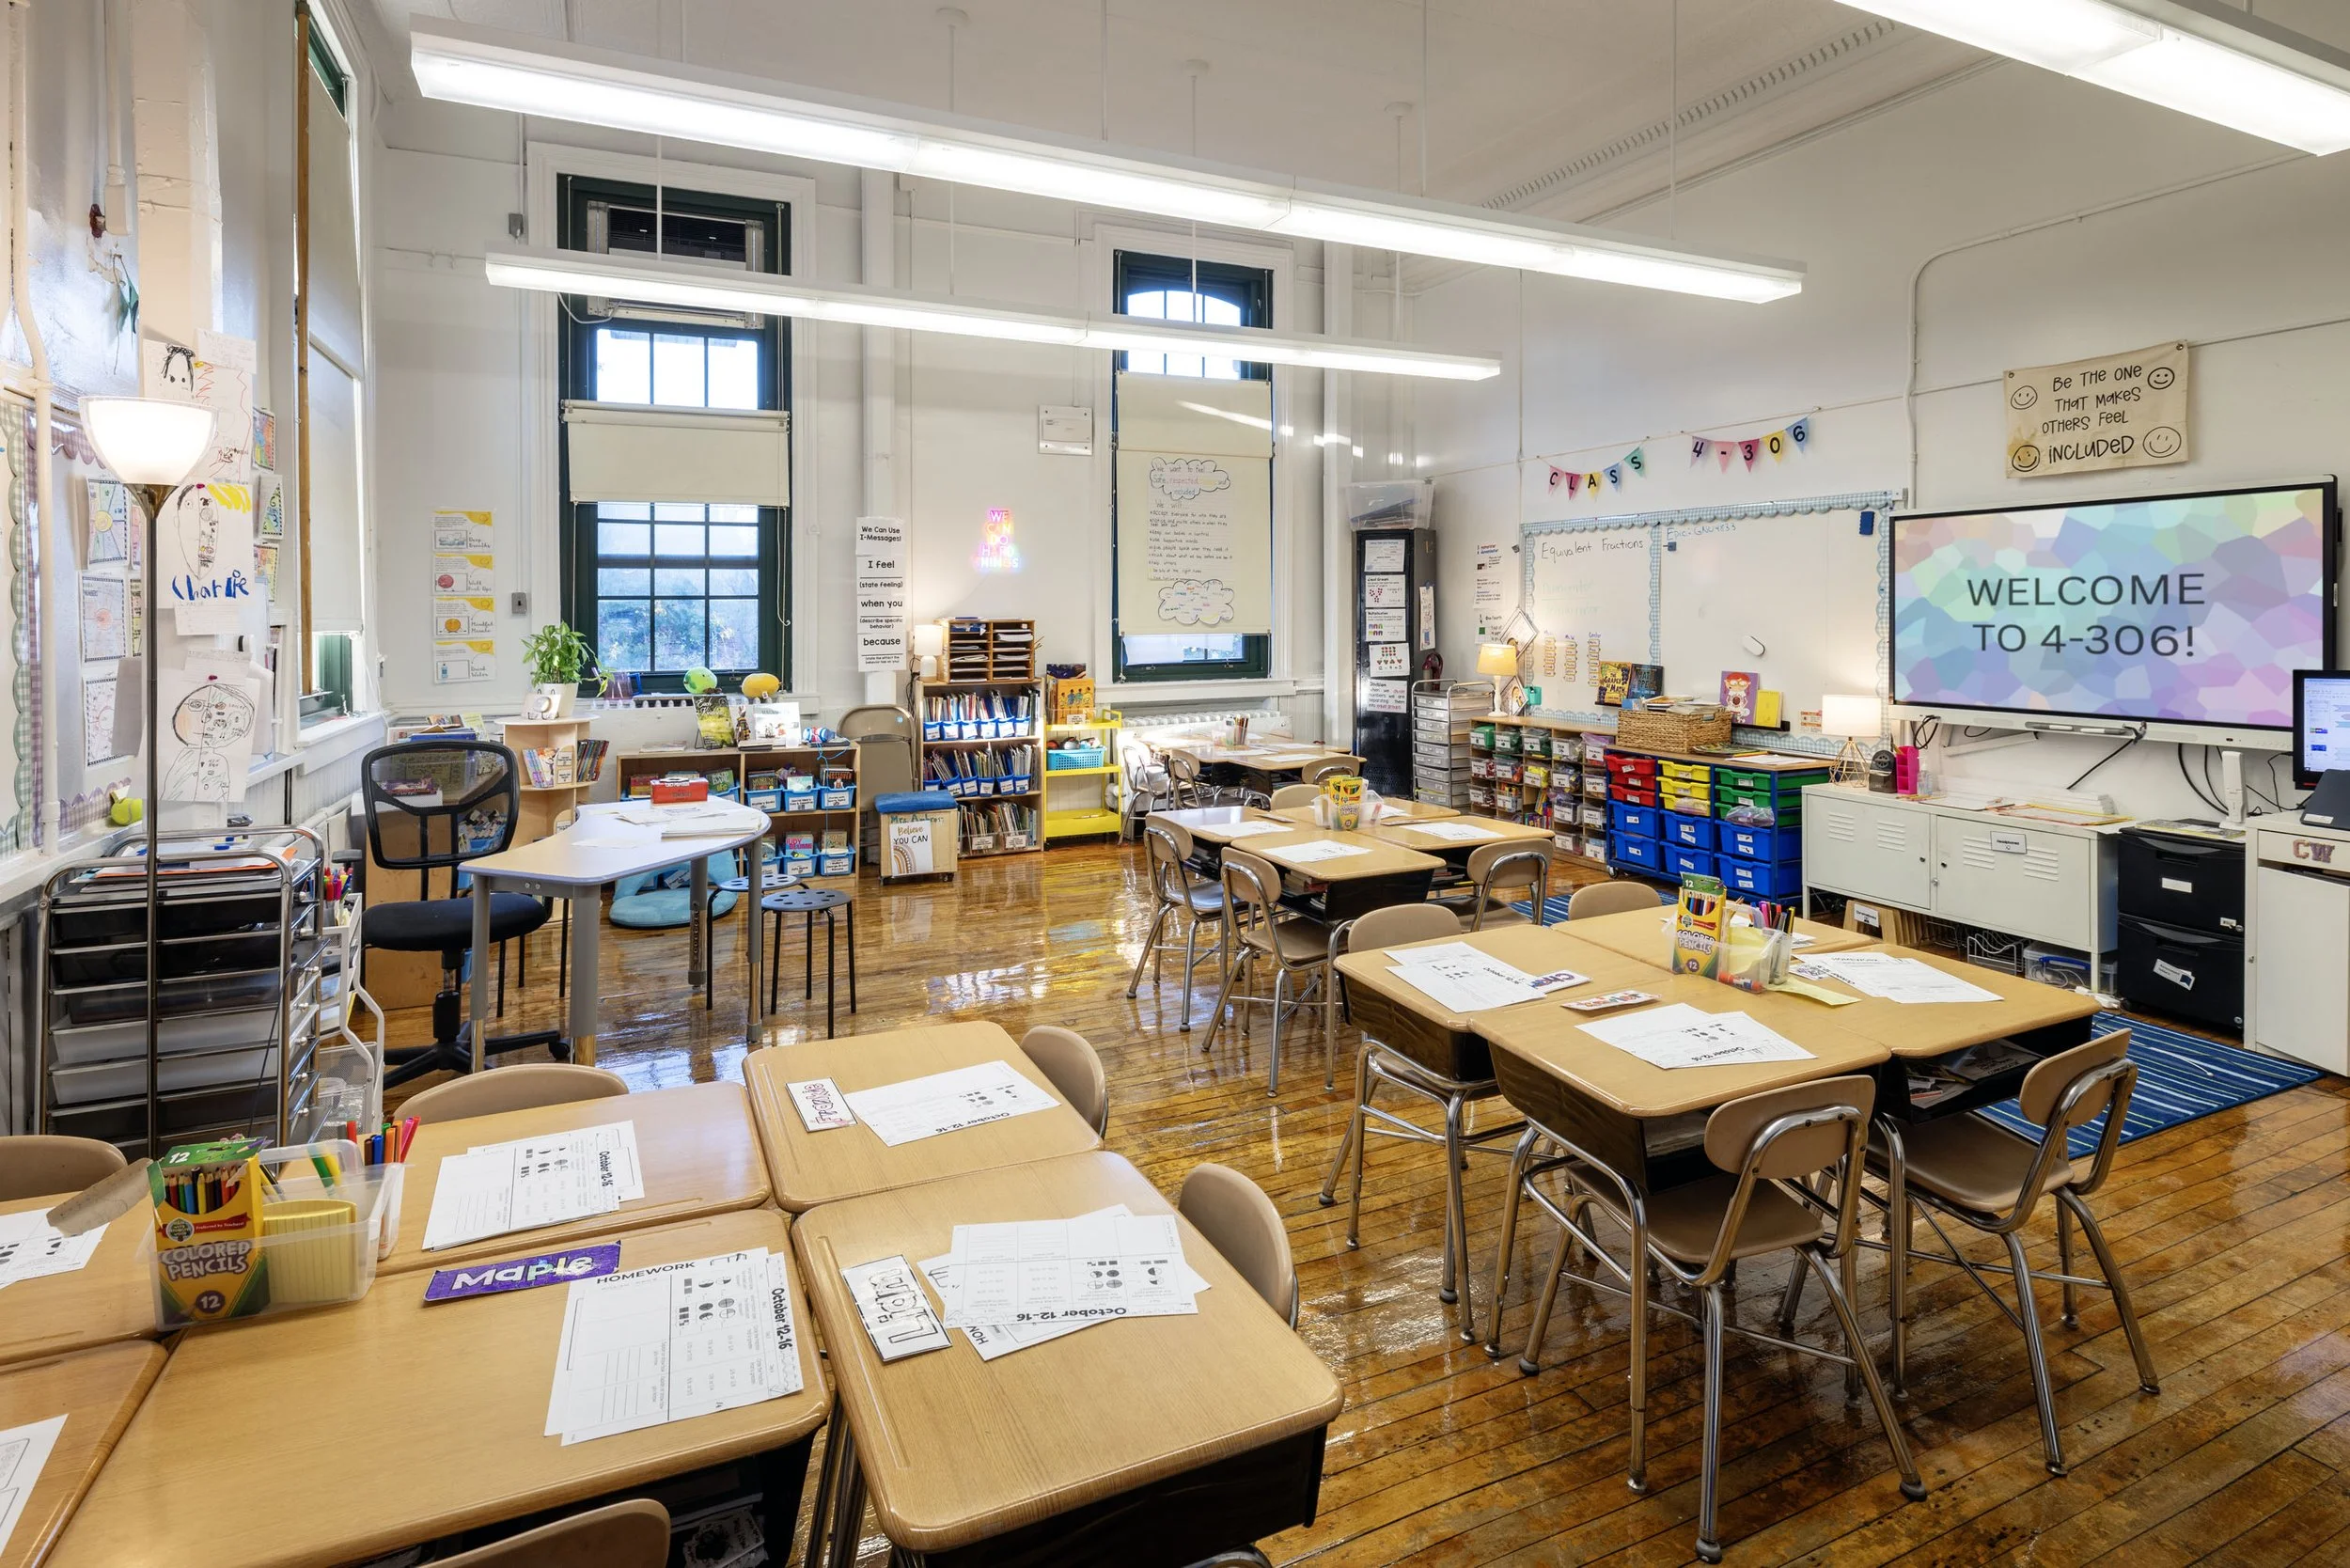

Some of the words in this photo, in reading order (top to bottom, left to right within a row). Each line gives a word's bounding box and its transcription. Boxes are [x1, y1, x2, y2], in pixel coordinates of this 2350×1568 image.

[1550, 456, 1642, 491] CLASS
[1692, 425, 1805, 461] 4-306
[990, 534, 1009, 545] DO
[1541, 541, 1593, 564] Equivalent
[1602, 538, 1644, 552] Fractions
[868, 560, 873, 569] I
[875, 560, 895, 569] feel
[172, 570, 249, 601] Charlie
[1967, 573, 2205, 607] WELCOME
[886, 601, 903, 609] you
[863, 637, 901, 646] because
[1972, 623, 2027, 652] TO
[2041, 623, 2195, 658] 4-306!
[1604, 676, 1622, 684] GRAPES
[898, 825, 924, 836] Believe
[893, 837, 909, 845] YOU
[911, 835, 929, 844] CAN
[2293, 839, 2336, 864] CW
[1685, 879, 1694, 887] 12
[1679, 937, 1713, 955] PENCILS
[1688, 961, 1698, 969] 12
[964, 1111, 1010, 1127] October
[935, 1122, 964, 1135] 12-16
[168, 1152, 191, 1164] 12
[599, 1151, 610, 1173] October
[160, 1241, 252, 1267] COLORED
[167, 1255, 248, 1281] PENCILS
[451, 1256, 595, 1292] Maple
[597, 1262, 696, 1284] HOMEWORK
[200, 1294, 222, 1310] 12
[771, 1287, 786, 1323] October
[869, 1268, 938, 1345] Liam
[1016, 1311, 1057, 1322] 12-16
[1061, 1307, 1127, 1318] October
[776, 1324, 793, 1351] 12-16
